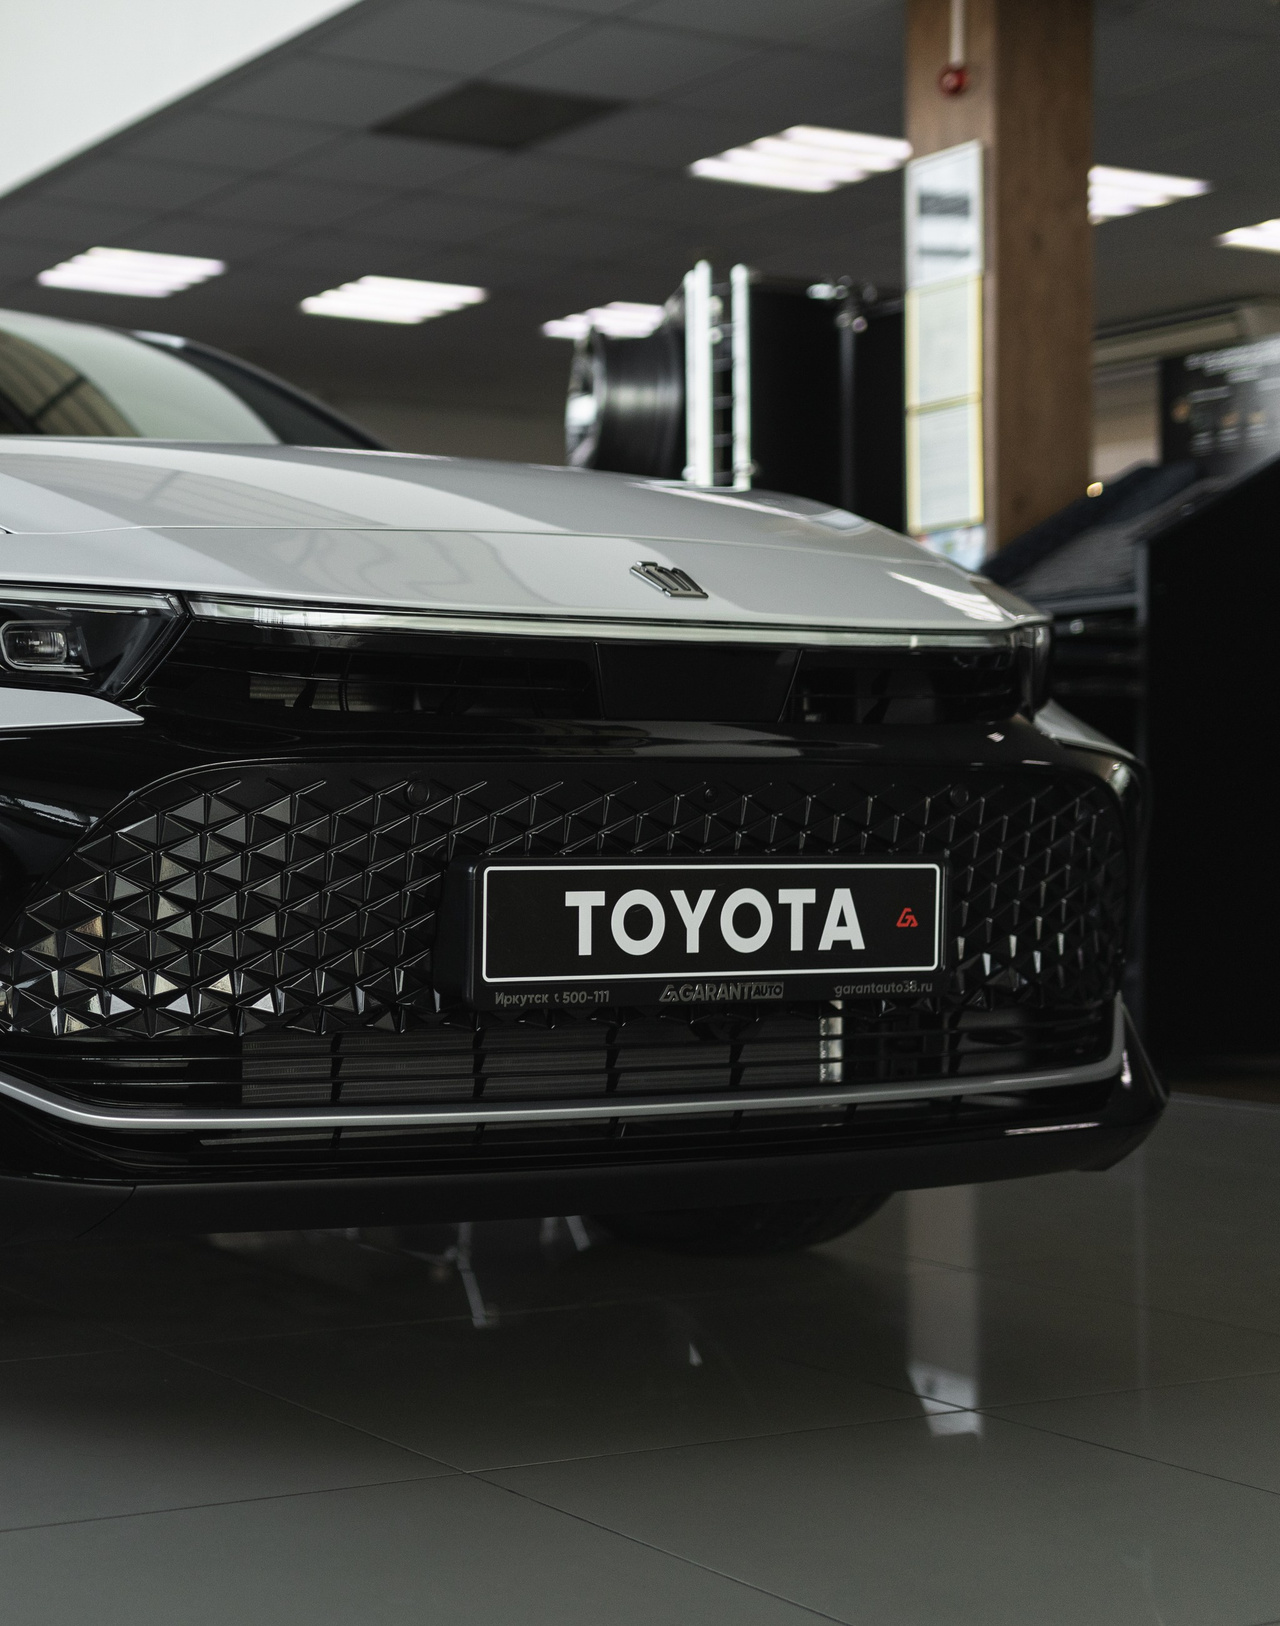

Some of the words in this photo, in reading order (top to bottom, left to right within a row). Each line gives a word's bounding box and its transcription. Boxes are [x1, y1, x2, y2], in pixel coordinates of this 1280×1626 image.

[565, 887, 865, 956] TOYOTA
[495, 991, 549, 1007] Иркутск
[562, 989, 610, 1004] 500-111
[833, 980, 933, 998] garantauto38.ru
